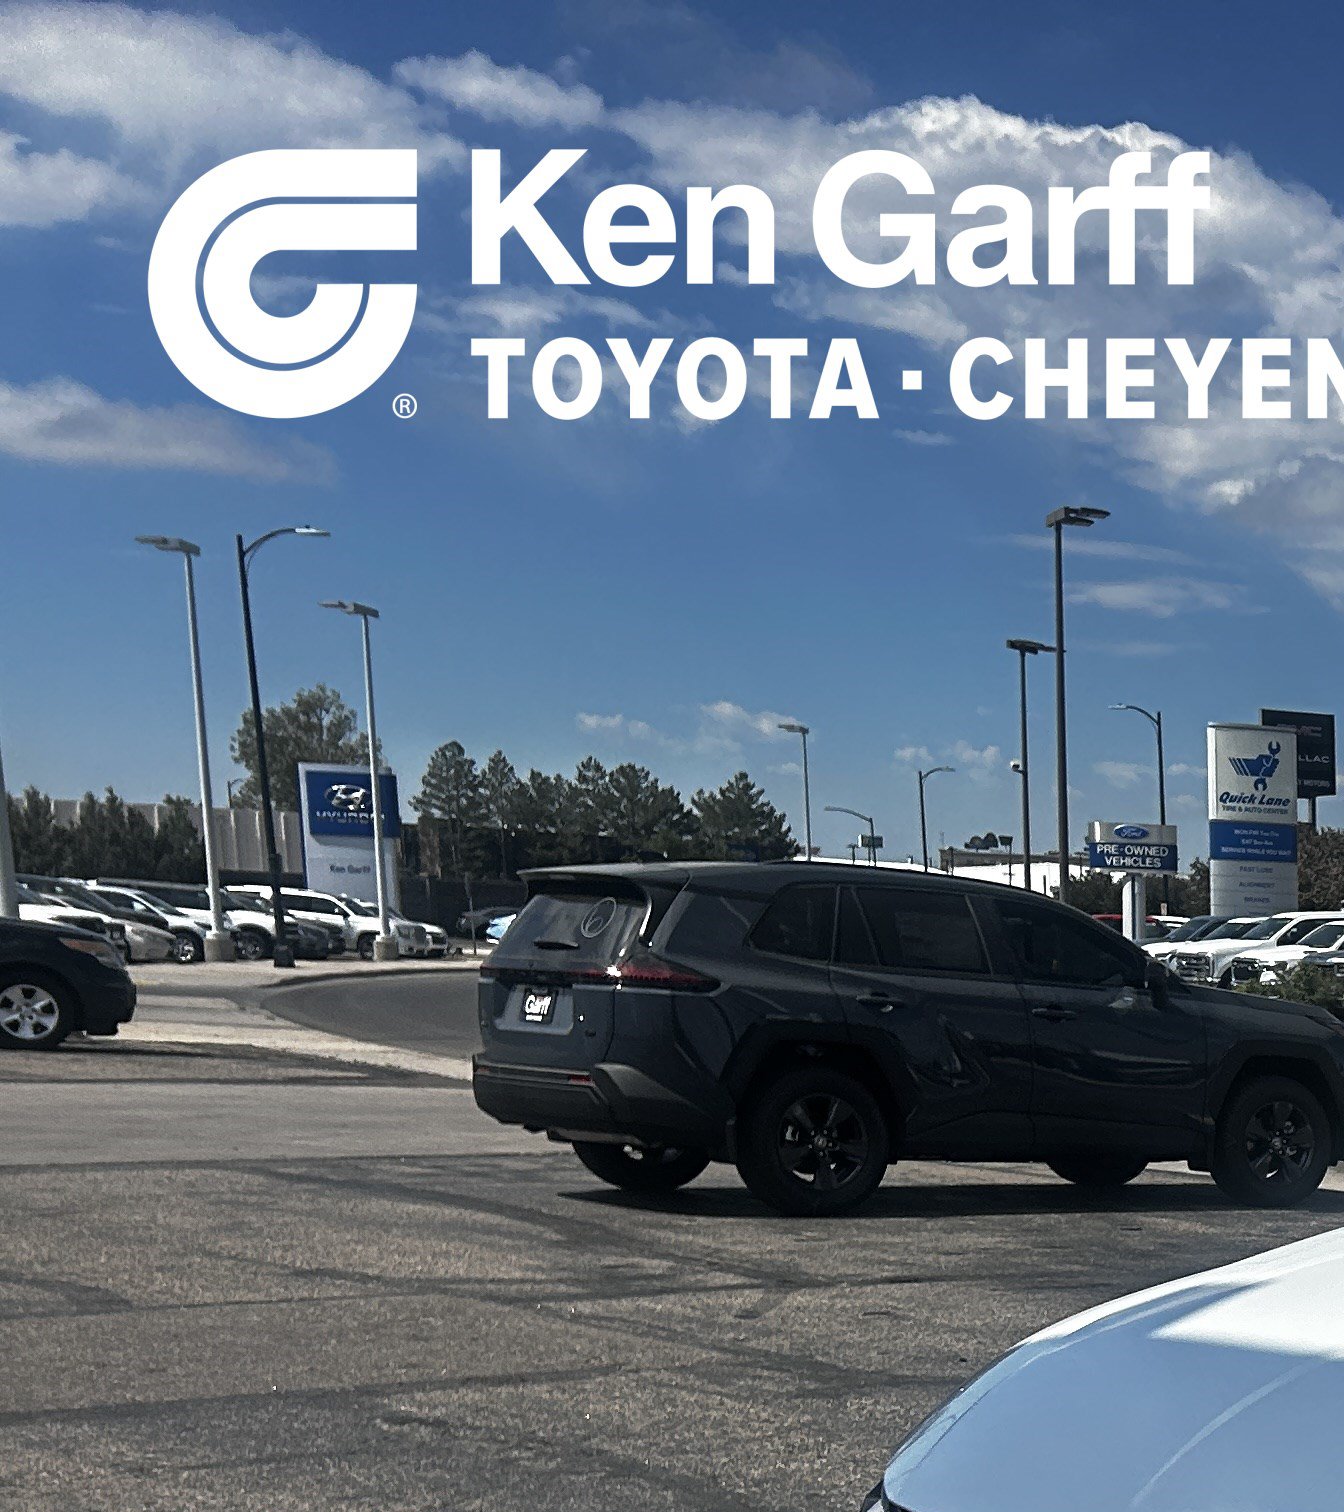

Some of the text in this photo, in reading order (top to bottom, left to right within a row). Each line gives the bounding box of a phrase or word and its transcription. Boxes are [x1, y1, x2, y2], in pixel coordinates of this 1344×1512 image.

[1219, 791, 1291, 807] Quick Lane
[1222, 804, 1237, 812] TIRE
[1121, 828, 1143, 838] Ford
[1105, 856, 1162, 868] VEHICLES
